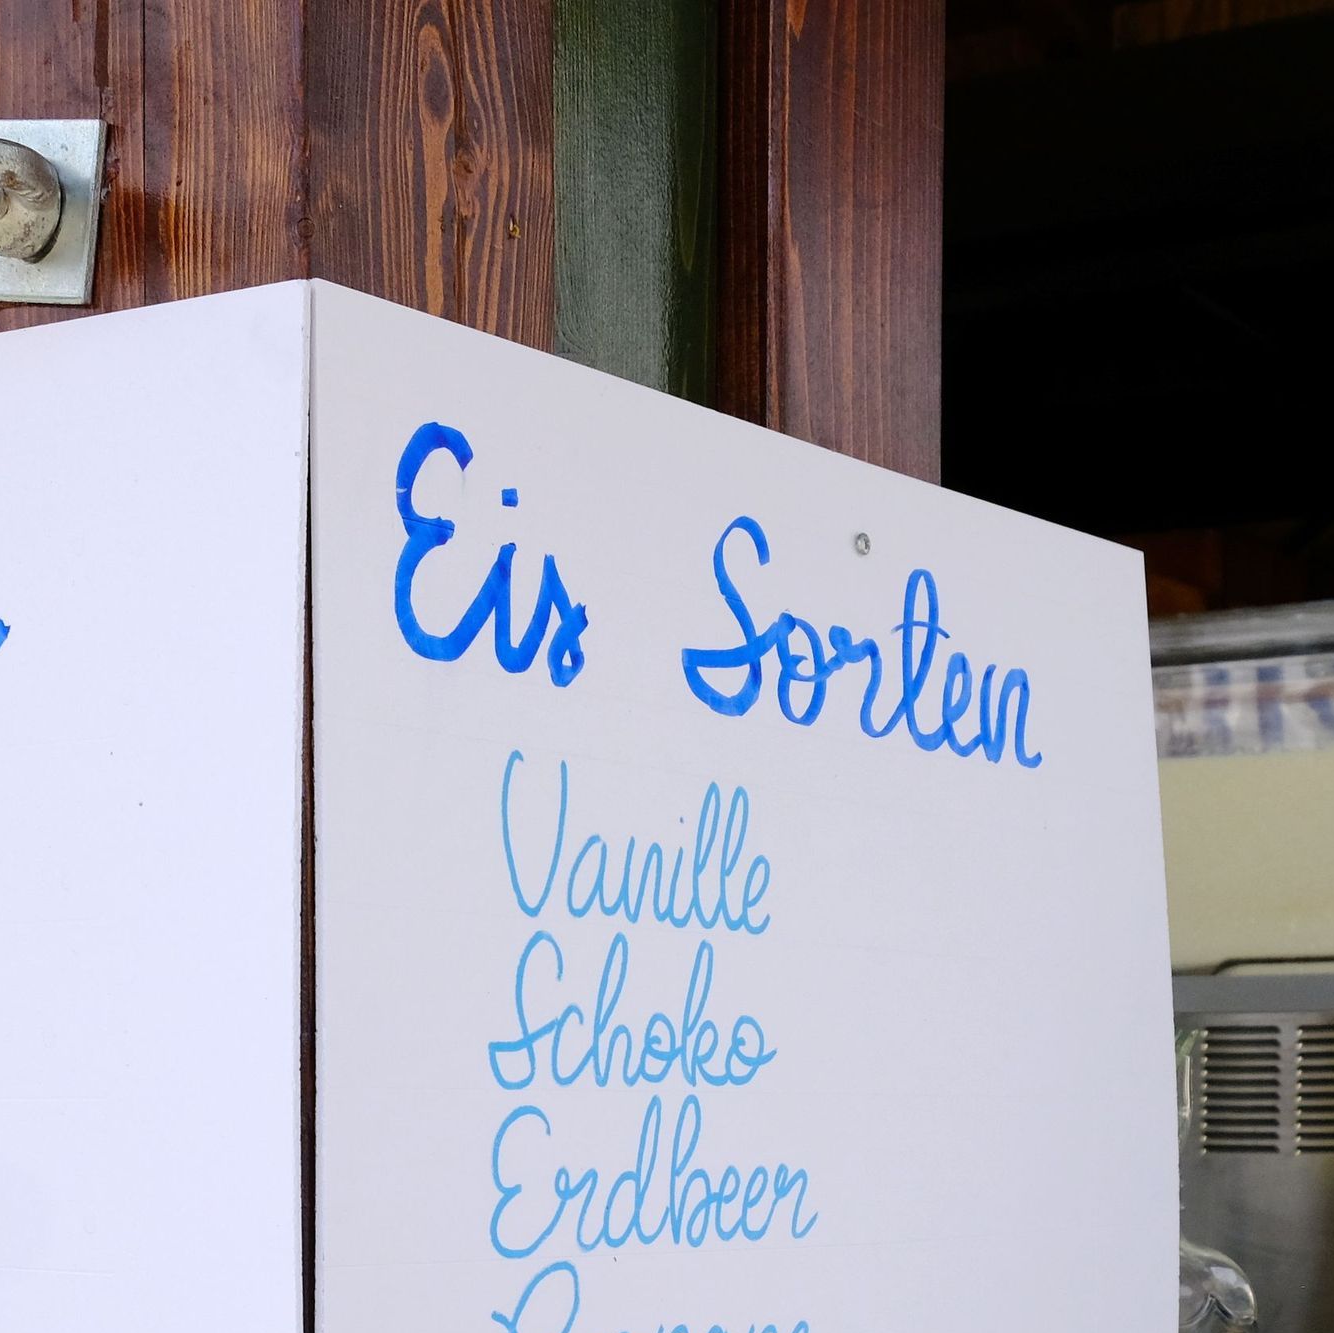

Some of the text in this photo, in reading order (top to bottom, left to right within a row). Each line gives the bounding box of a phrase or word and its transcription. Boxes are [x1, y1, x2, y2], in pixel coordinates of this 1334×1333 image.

[394, 420, 1043, 769] Eis Sorten
[501, 750, 771, 936] Vanille
[488, 930, 778, 1091] Schoko
[489, 1094, 818, 1260] Erdbeer
